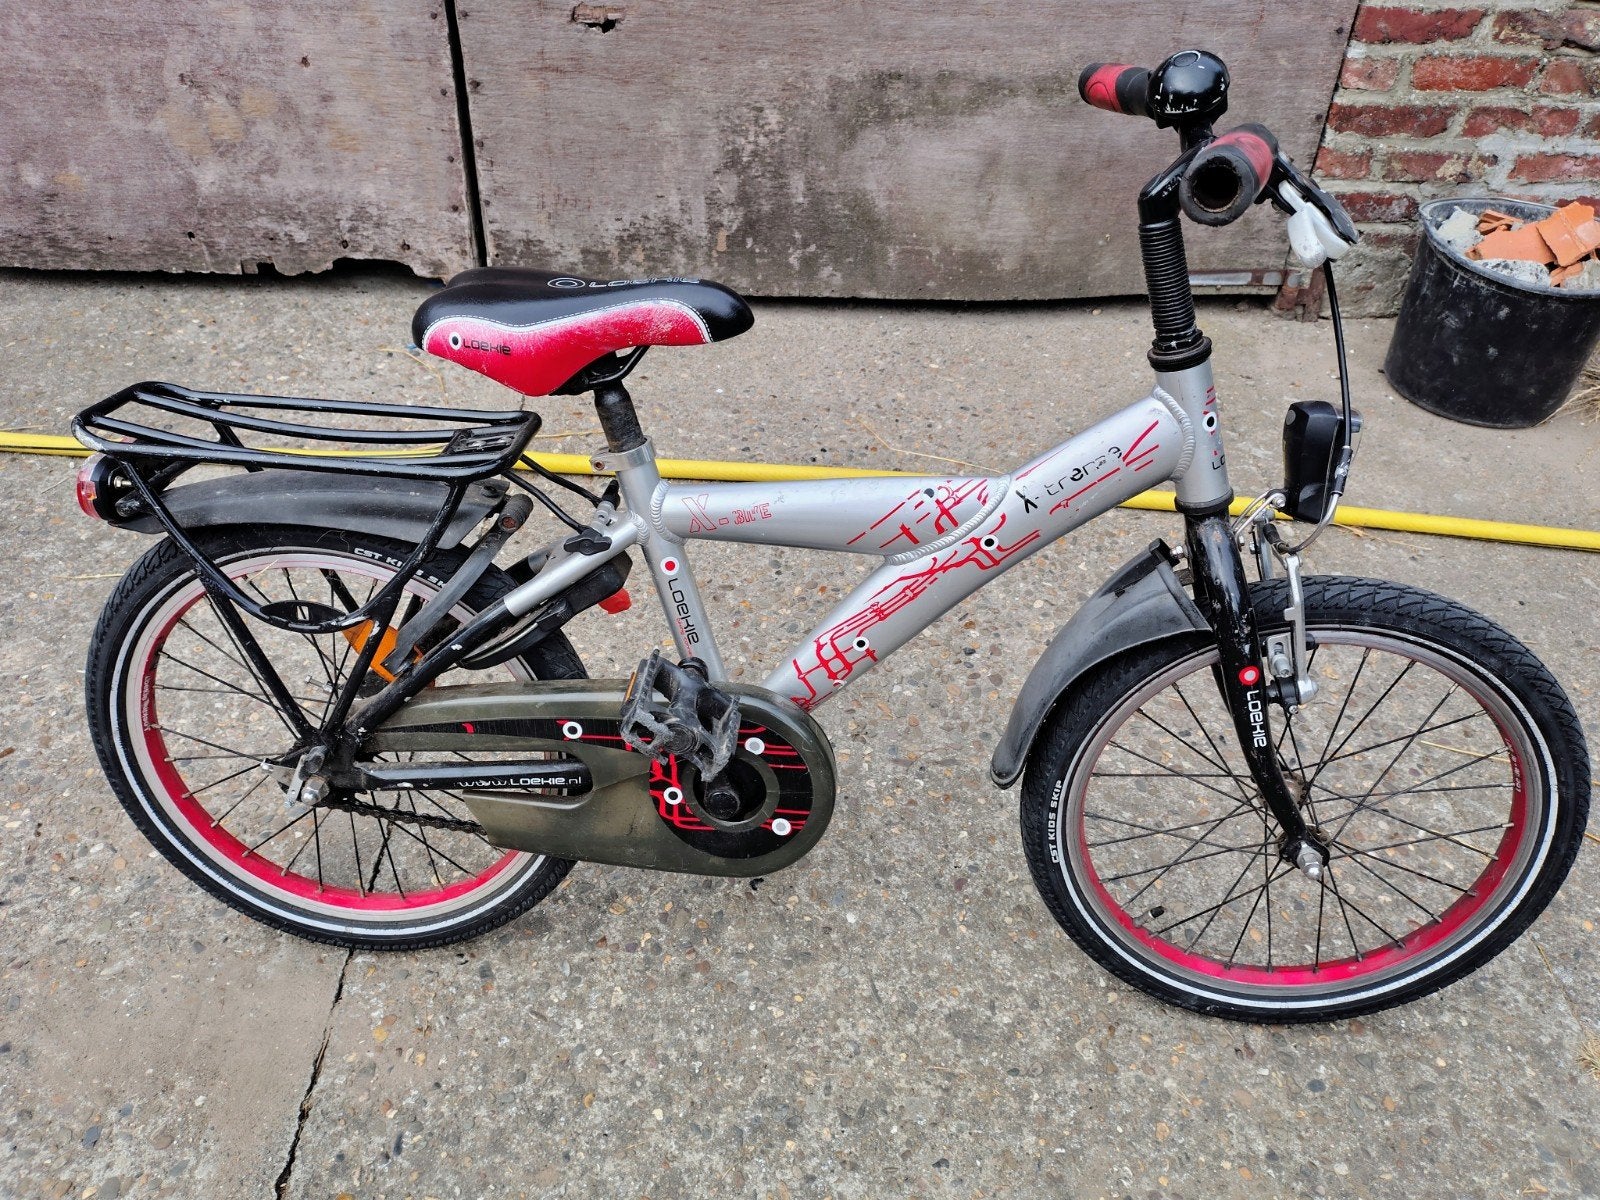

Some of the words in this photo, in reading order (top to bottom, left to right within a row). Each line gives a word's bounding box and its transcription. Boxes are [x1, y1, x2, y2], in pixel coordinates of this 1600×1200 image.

[353, 547, 383, 560] CST
[385, 556, 425, 577] KIS
[1050, 779, 1062, 809] SKIP
[1047, 811, 1057, 841] KIDS
[1048, 843, 1061, 864] CST
